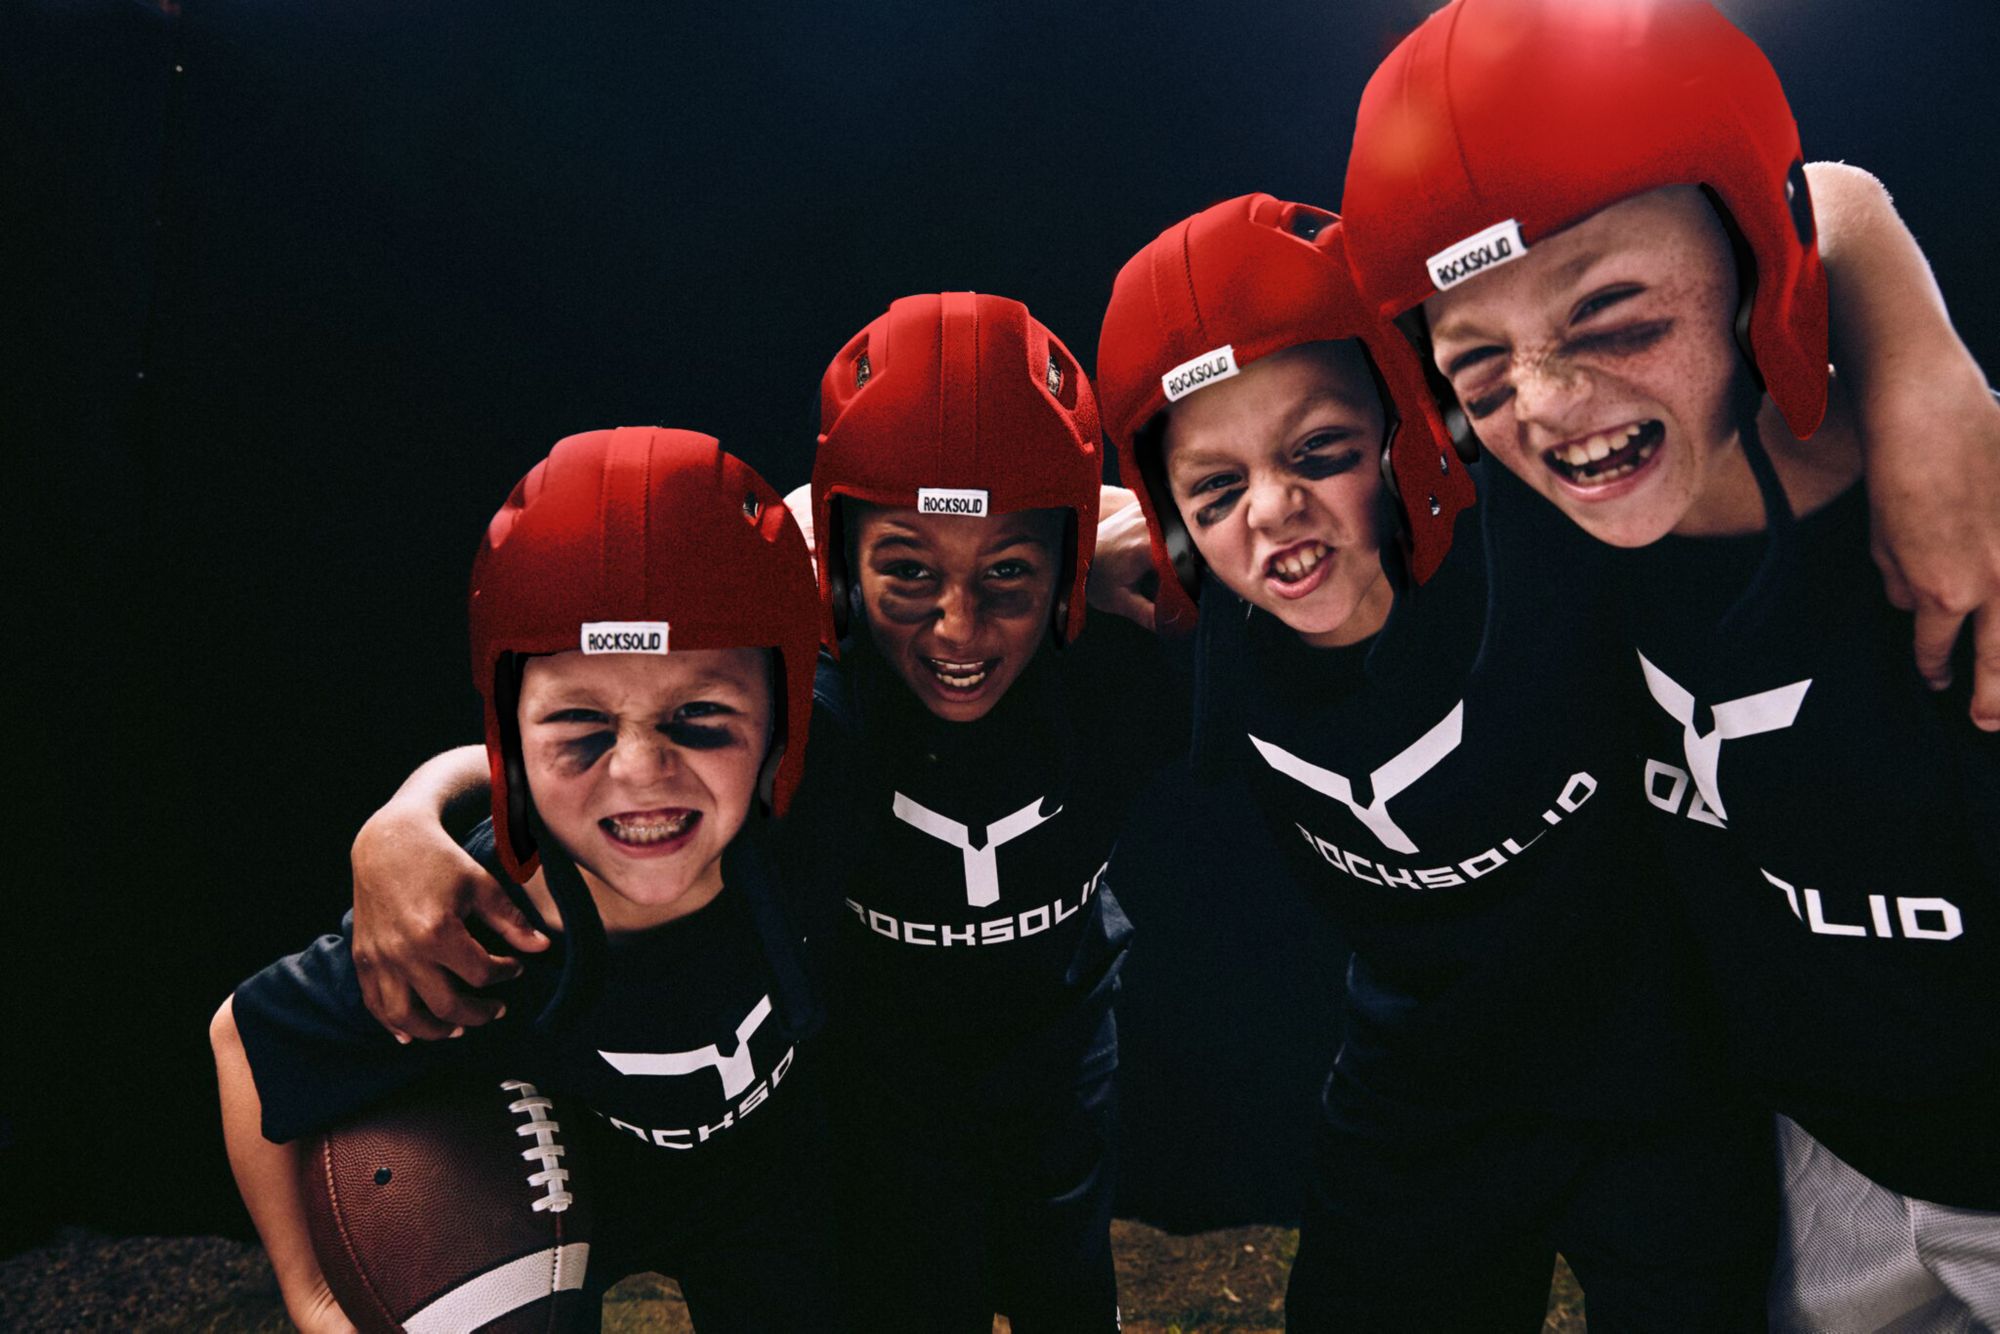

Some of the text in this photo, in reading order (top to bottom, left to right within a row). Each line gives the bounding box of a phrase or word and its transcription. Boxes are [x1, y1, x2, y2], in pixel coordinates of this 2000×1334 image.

[1437, 236, 1512, 286] ROCKSOLID
[1168, 356, 1229, 396] ROCKSOLID
[923, 496, 983, 514] ROCKSOLID
[588, 632, 661, 651] ROCKSOLID
